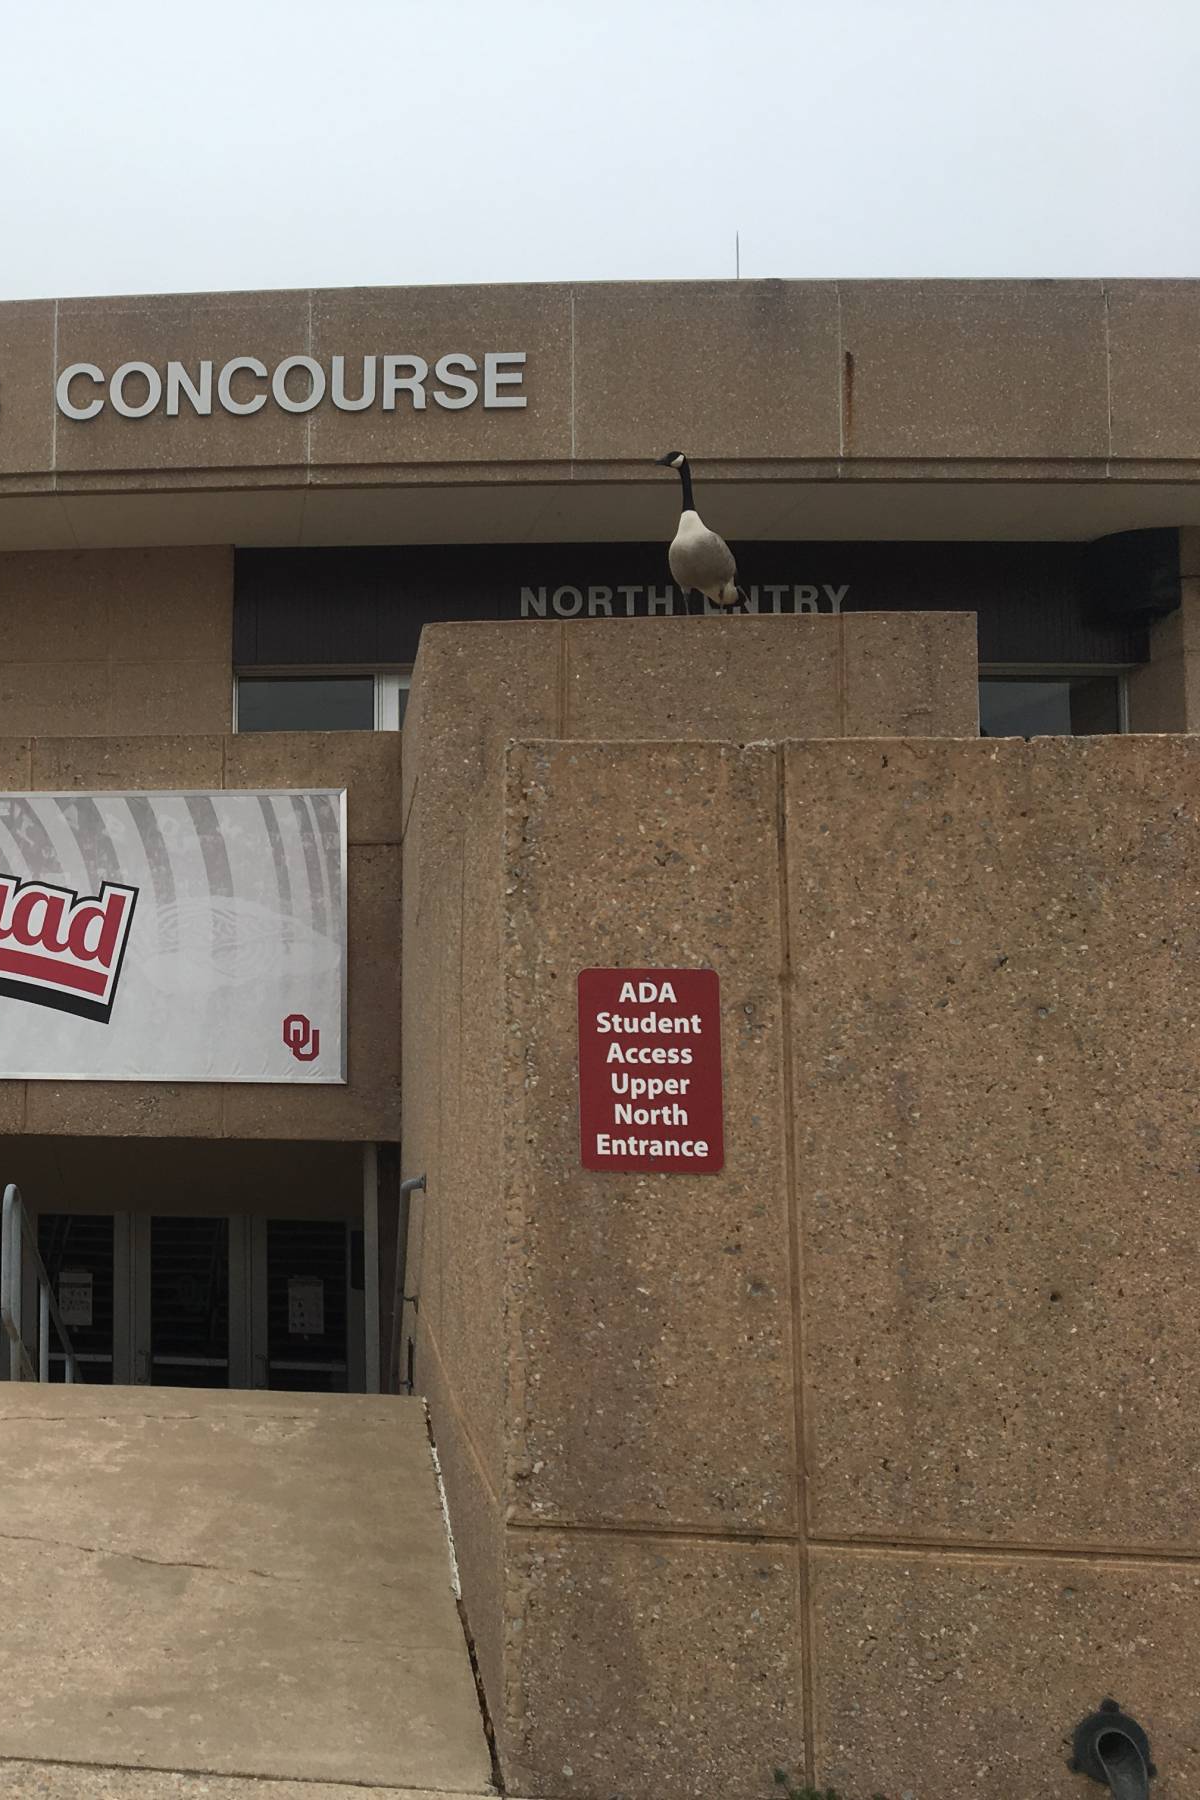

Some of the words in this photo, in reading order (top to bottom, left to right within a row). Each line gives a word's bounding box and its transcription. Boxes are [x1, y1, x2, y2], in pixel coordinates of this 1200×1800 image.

[56, 352, 528, 421] CONCOURSE
[520, 585, 674, 617] NORTH
[618, 982, 677, 1003] ADA
[596, 1012, 702, 1034] Student
[606, 1042, 693, 1064] Access
[611, 1072, 690, 1100] Upper
[614, 1103, 689, 1126] North
[596, 1133, 709, 1157] Entrance
